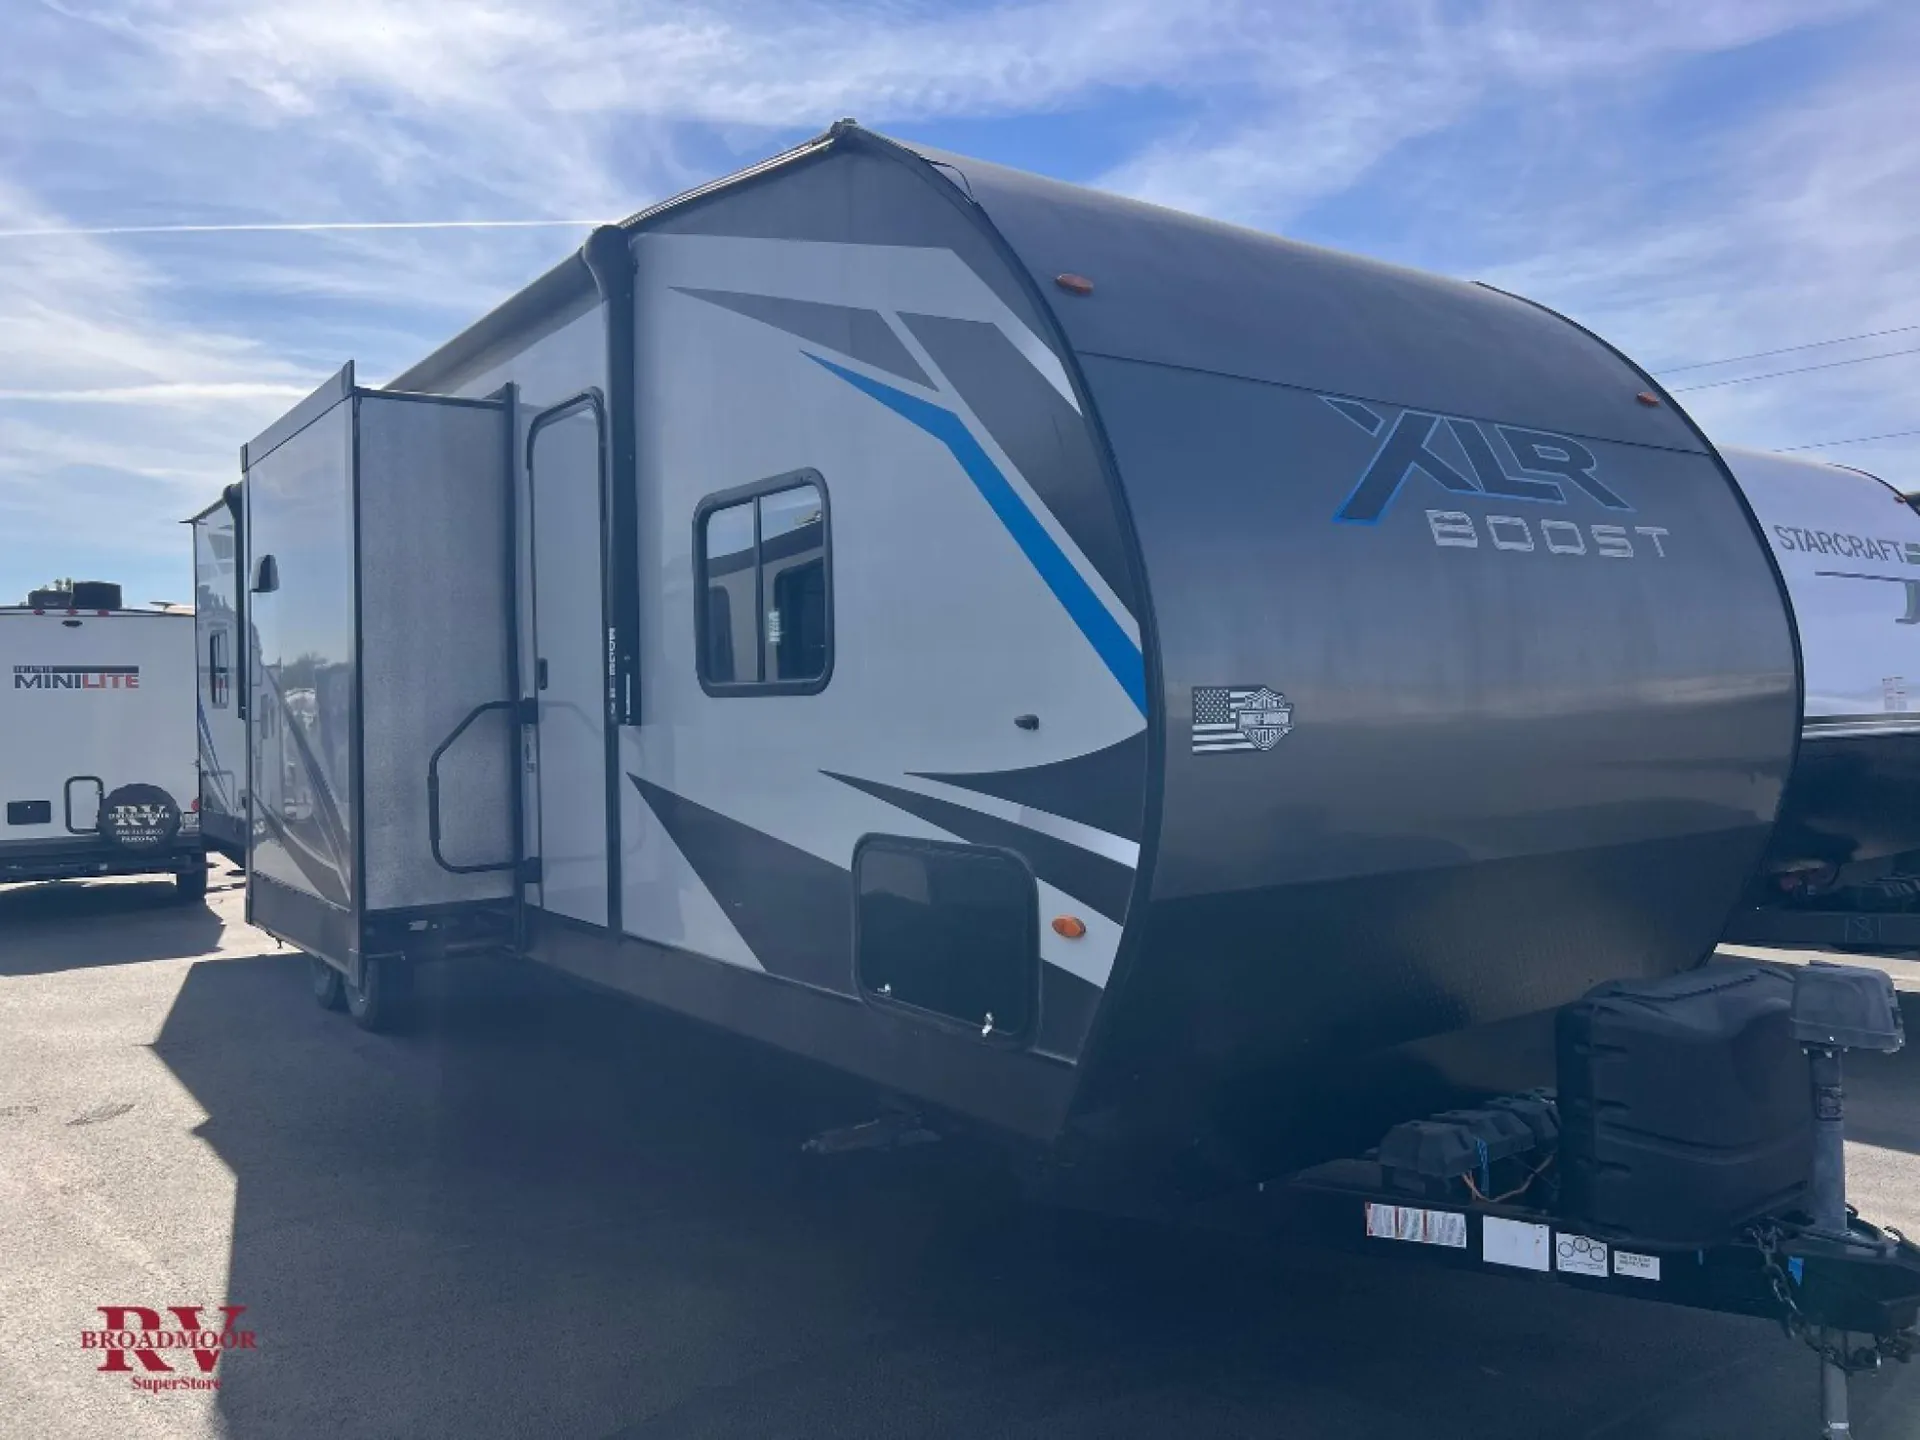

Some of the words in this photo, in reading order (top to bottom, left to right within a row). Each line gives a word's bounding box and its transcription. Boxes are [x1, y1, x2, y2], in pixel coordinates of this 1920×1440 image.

[1317, 394, 1637, 526] XLR
[1424, 509, 1670, 558] BOOST
[1773, 524, 1905, 563] STARCRAFT
[14, 673, 139, 689] MINILITE
[115, 804, 166, 826] RV
